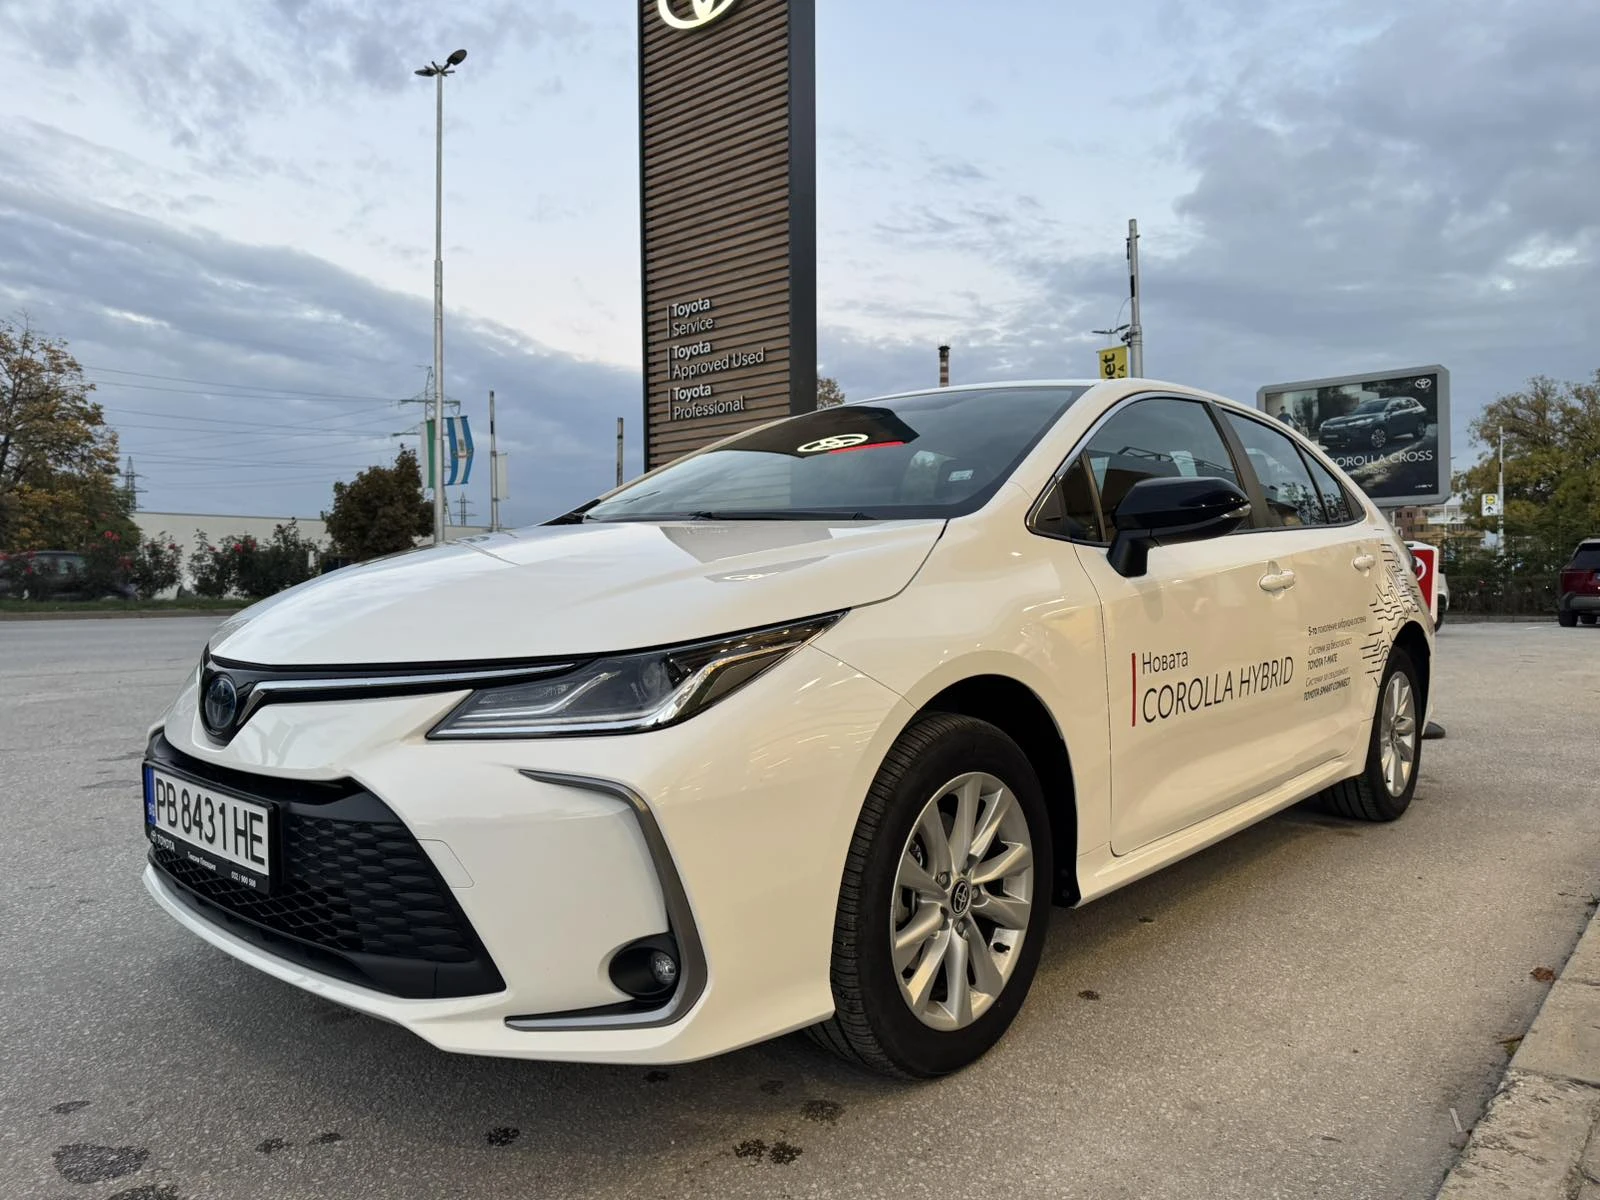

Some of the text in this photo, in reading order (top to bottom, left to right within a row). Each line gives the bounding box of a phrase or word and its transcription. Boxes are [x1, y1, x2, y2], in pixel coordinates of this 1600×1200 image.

[672, 298, 711, 318] Toyota
[672, 317, 714, 337] Service
[672, 341, 711, 361] Toyota
[673, 347, 765, 380] Approved Used
[673, 383, 712, 402] Toyota
[674, 395, 745, 420] Professional
[1390, 450, 1433, 464] CROSS
[1142, 651, 1189, 675] Новата
[1142, 671, 1234, 723] COROLLA
[1239, 656, 1294, 698] HYBRID
[155, 778, 266, 866] PB 8431 HE
